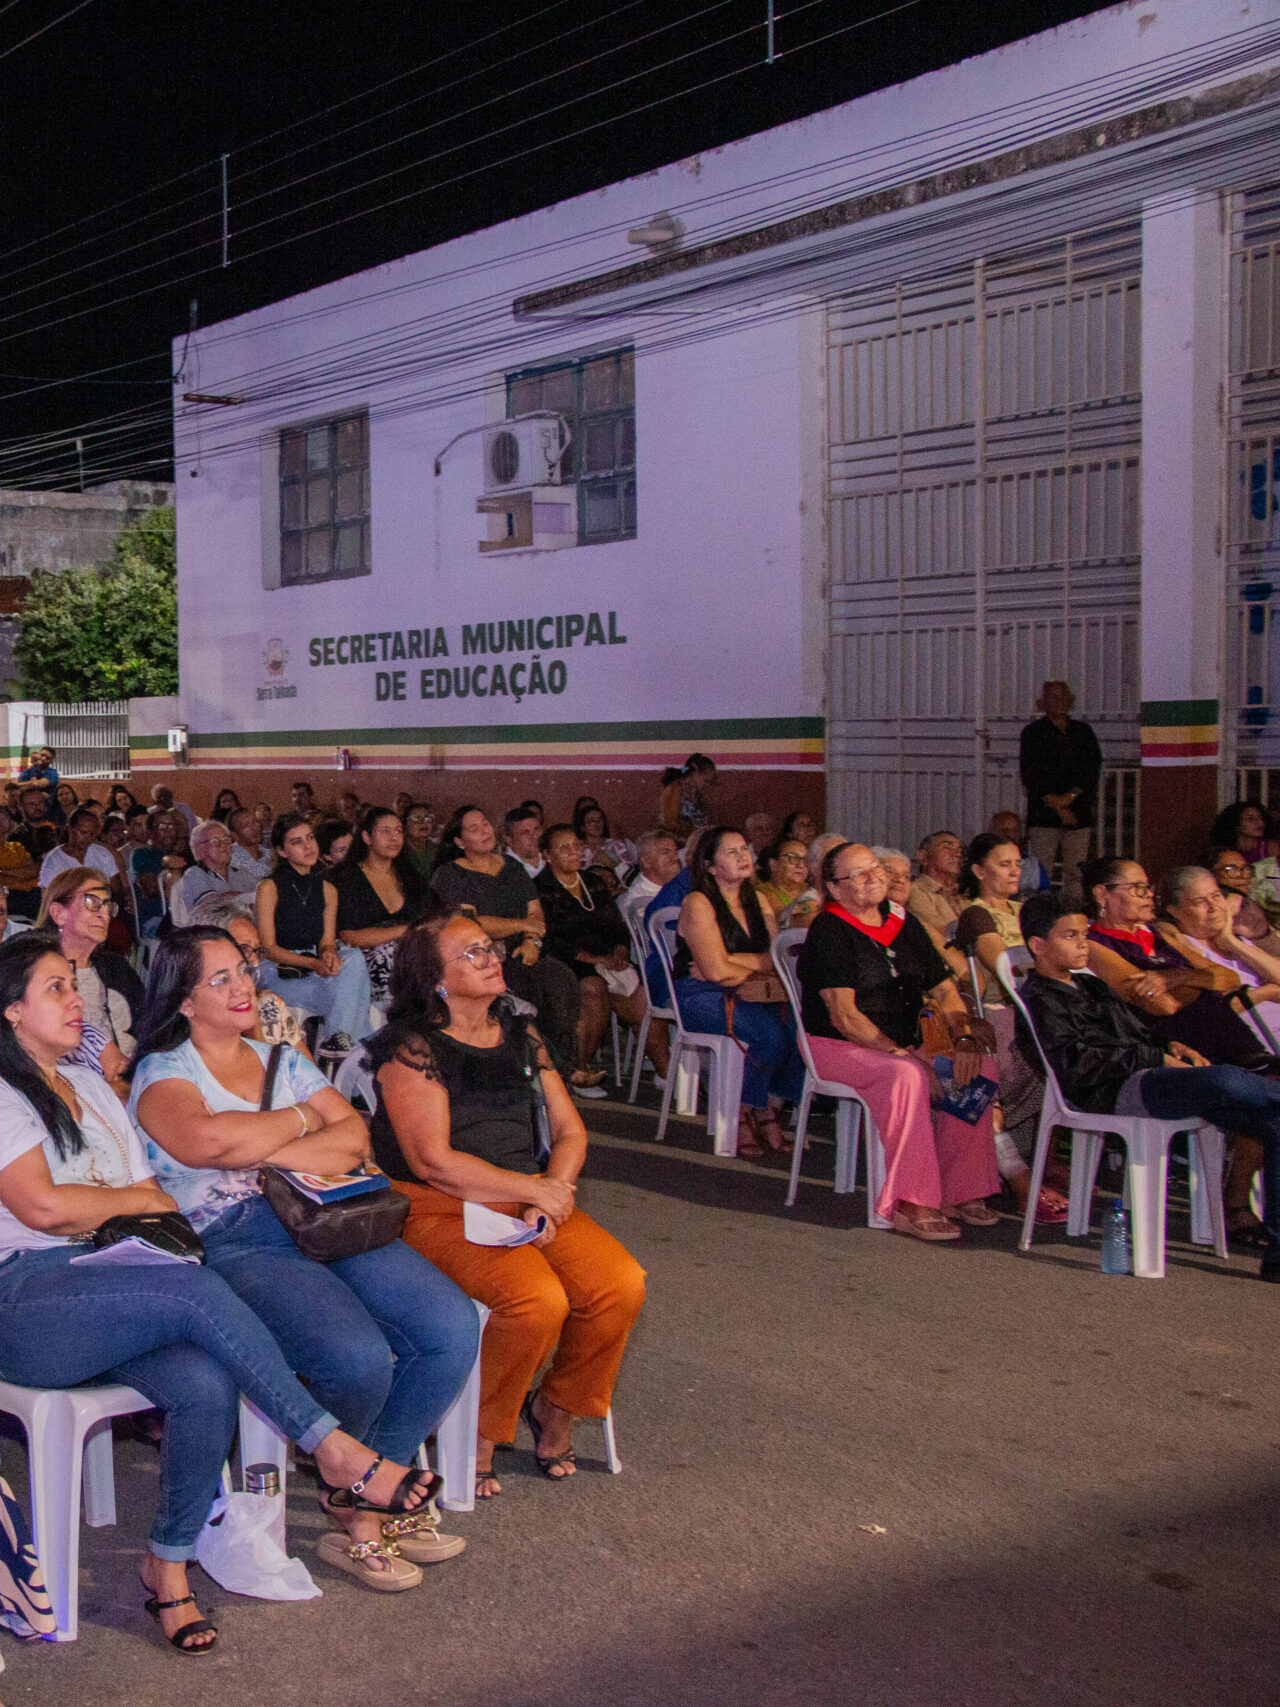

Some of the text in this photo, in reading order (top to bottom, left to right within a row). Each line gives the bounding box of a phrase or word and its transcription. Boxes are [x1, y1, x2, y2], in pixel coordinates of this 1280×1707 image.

[309, 611, 628, 667] SECRETARIA MUNICIPAL
[376, 655, 568, 703] DE EDUCAÇÃO
